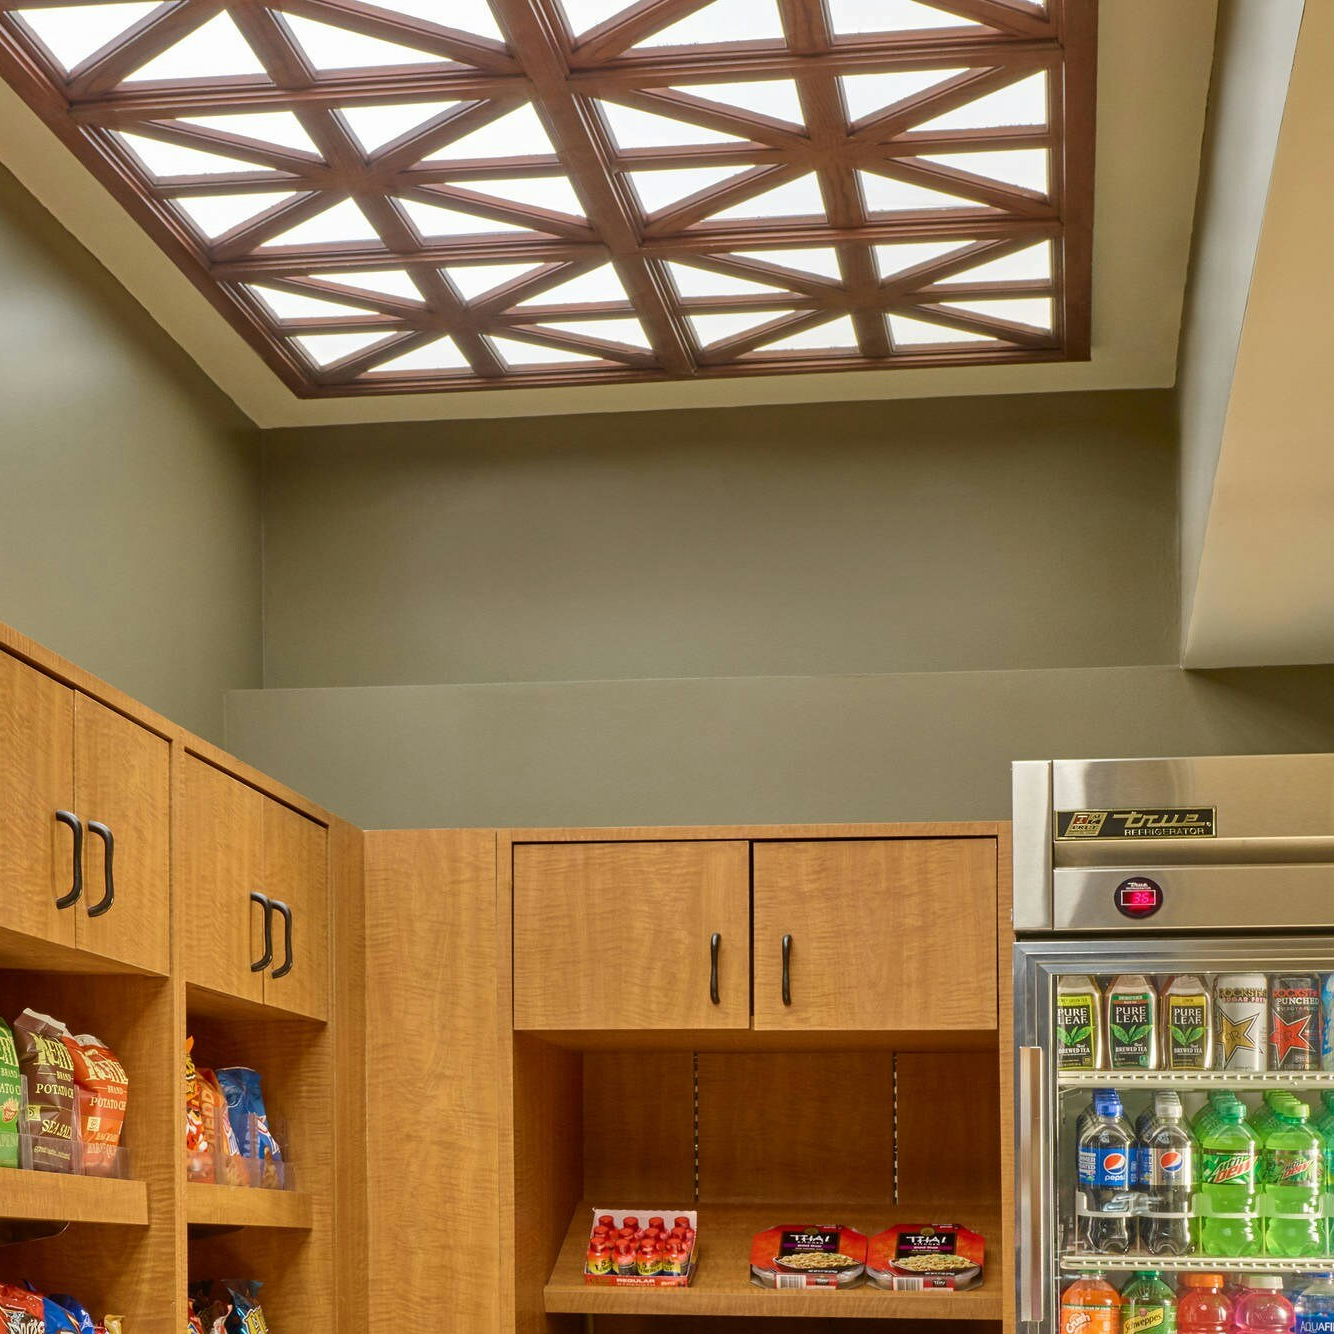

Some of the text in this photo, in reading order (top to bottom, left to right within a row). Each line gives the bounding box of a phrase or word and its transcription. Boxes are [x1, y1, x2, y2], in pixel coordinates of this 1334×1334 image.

[1124, 828, 1204, 836] REFRIGERATOR
[1277, 998, 1319, 1006] PUNCHED
[1057, 1008, 1087, 1016] PURE
[1116, 1006, 1146, 1015] PURE
[1174, 1008, 1202, 1016] PURE
[1058, 1016, 1088, 1024] LEAF
[1116, 1015, 1147, 1023] LEAF
[1174, 1016, 1202, 1024] LEAF
[36, 1084, 67, 1097] POTATO
[89, 1097, 117, 1110] POTATO
[1105, 1173, 1126, 1182] pepsi
[790, 1234, 831, 1243] THAI
[907, 1236, 947, 1244] THAI
[1066, 1312, 1091, 1334] Crush
[1124, 1313, 1163, 1334] Schweppes
